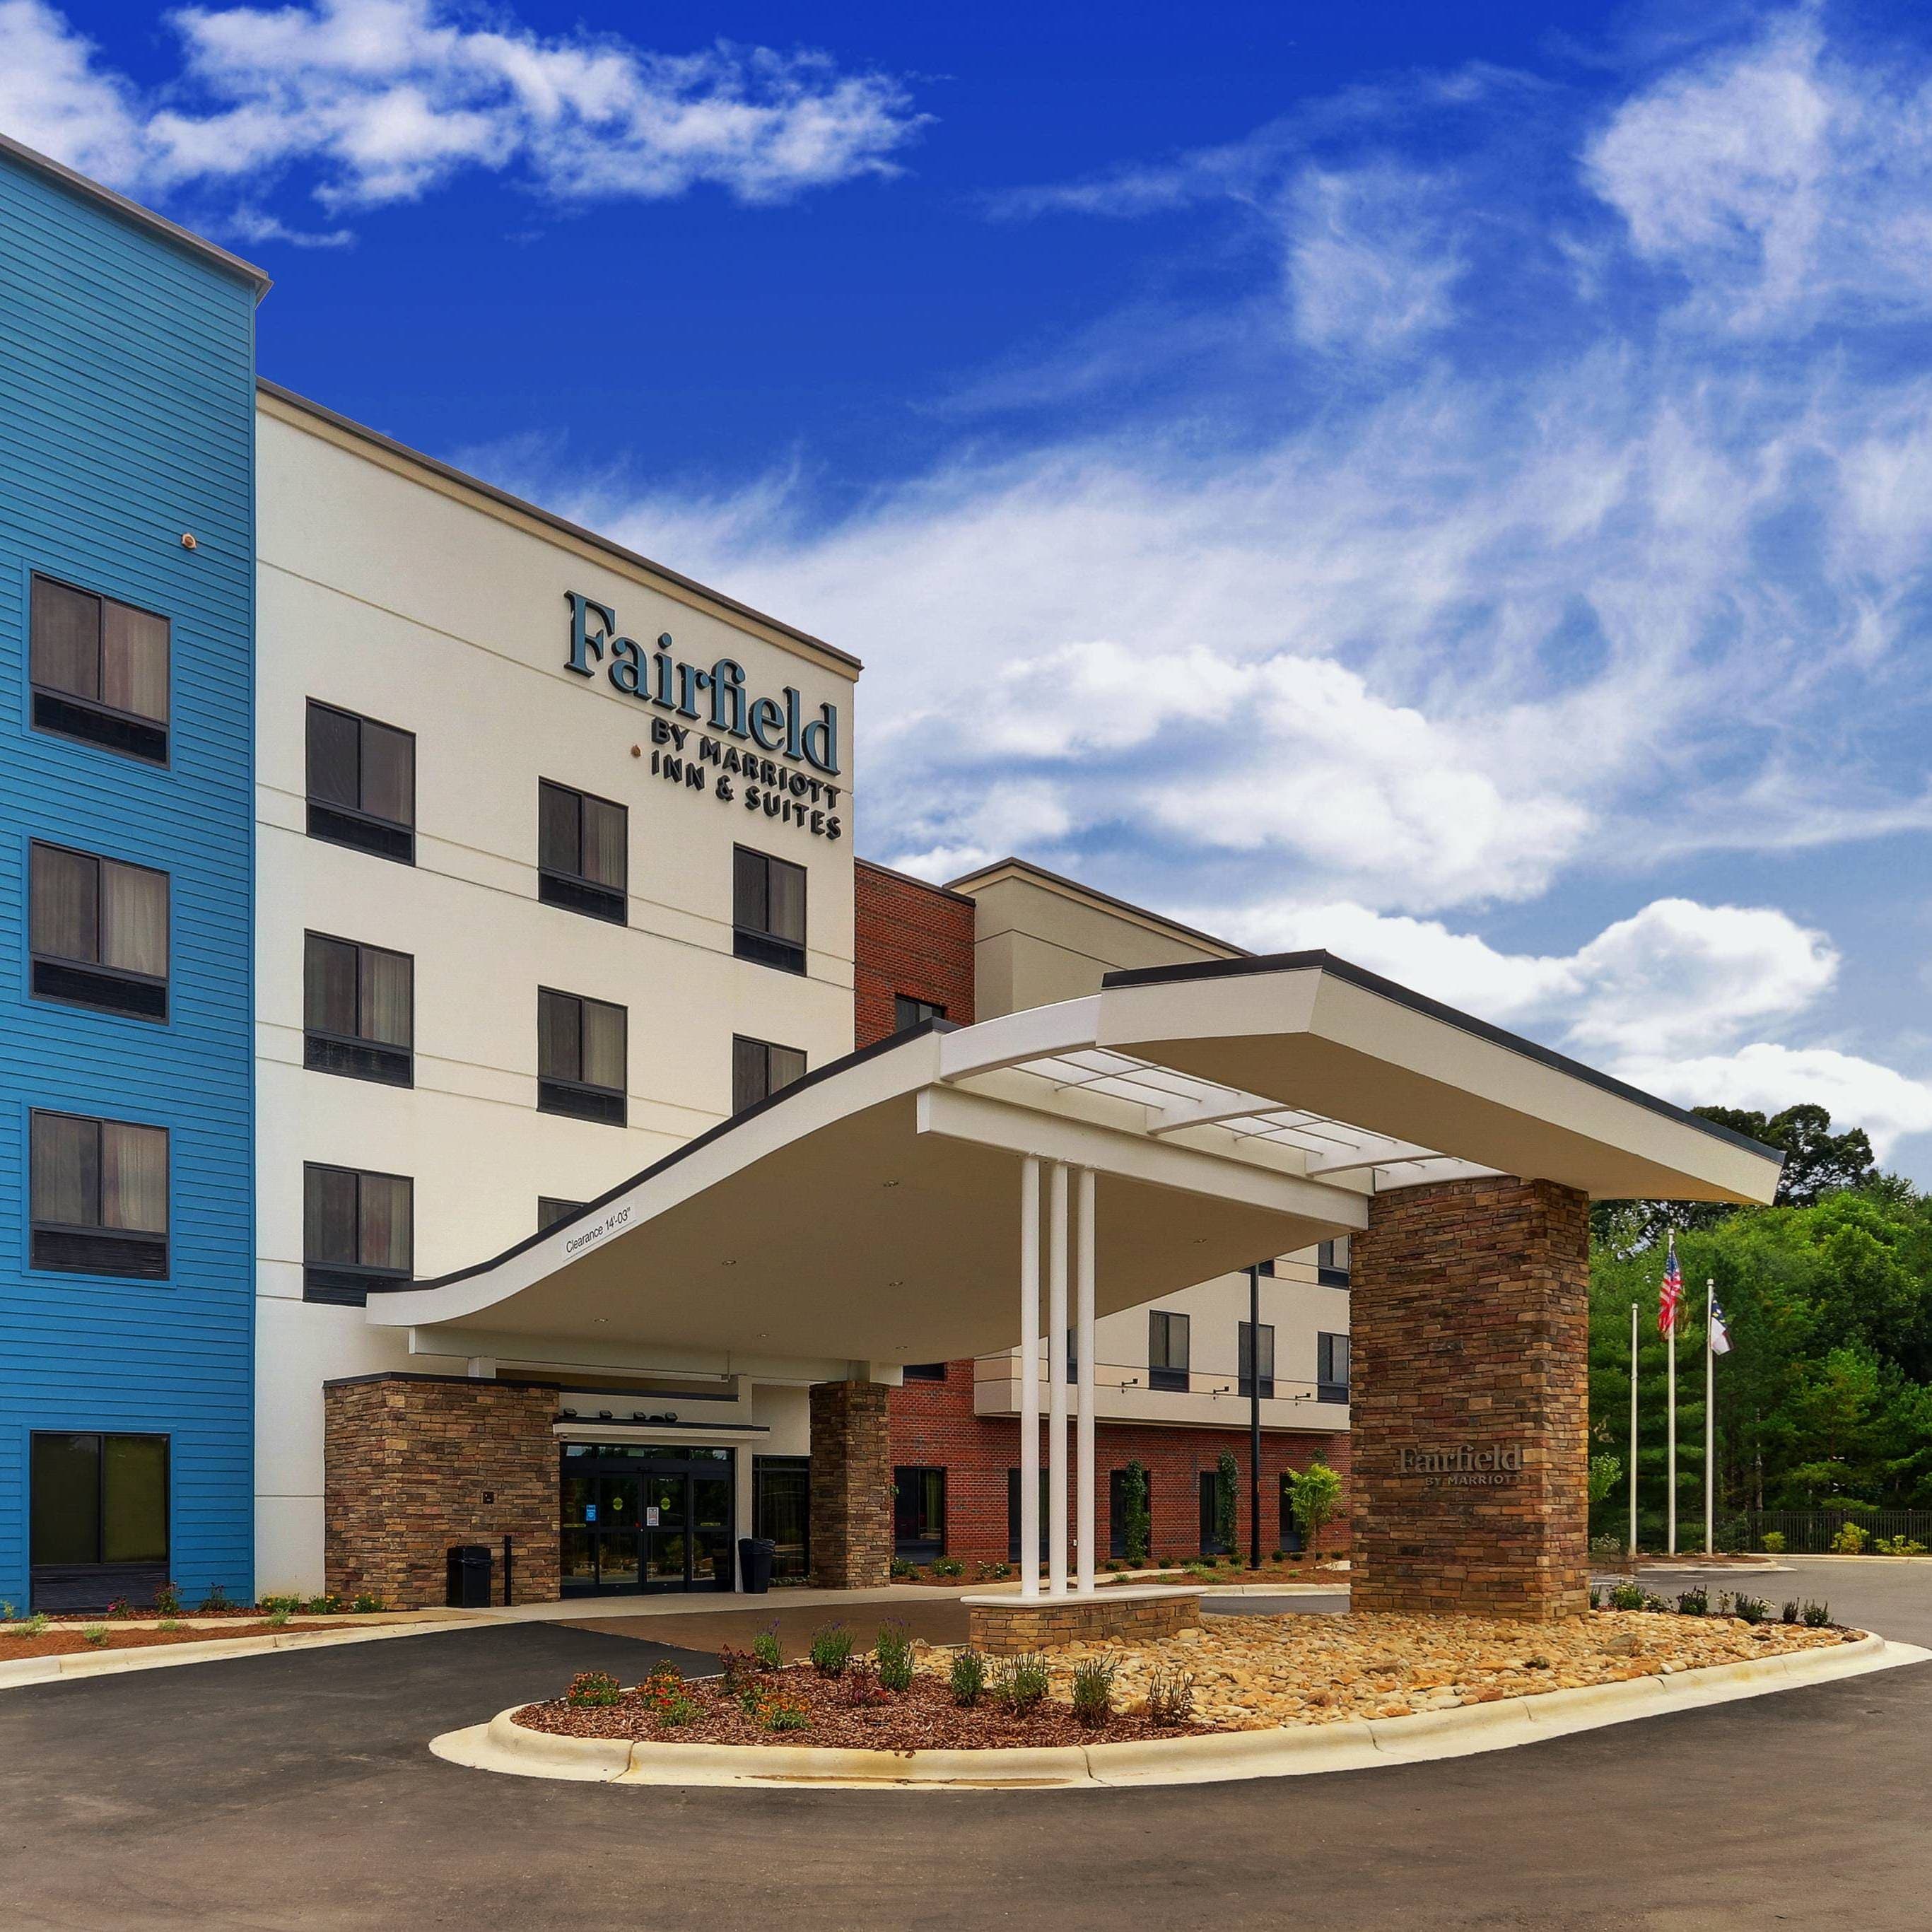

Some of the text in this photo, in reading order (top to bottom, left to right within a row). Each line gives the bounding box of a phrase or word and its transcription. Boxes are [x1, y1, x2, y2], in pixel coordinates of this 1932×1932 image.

[563, 590, 841, 776] Fairfield
[651, 716, 841, 809] BY MARRIOTT
[651, 749, 841, 840] INN & SUITES
[566, 1226, 604, 1253] Clearance
[1393, 1444, 1522, 1474] Fairfield
[1425, 1475, 1523, 1486] BY MARRIOTT
